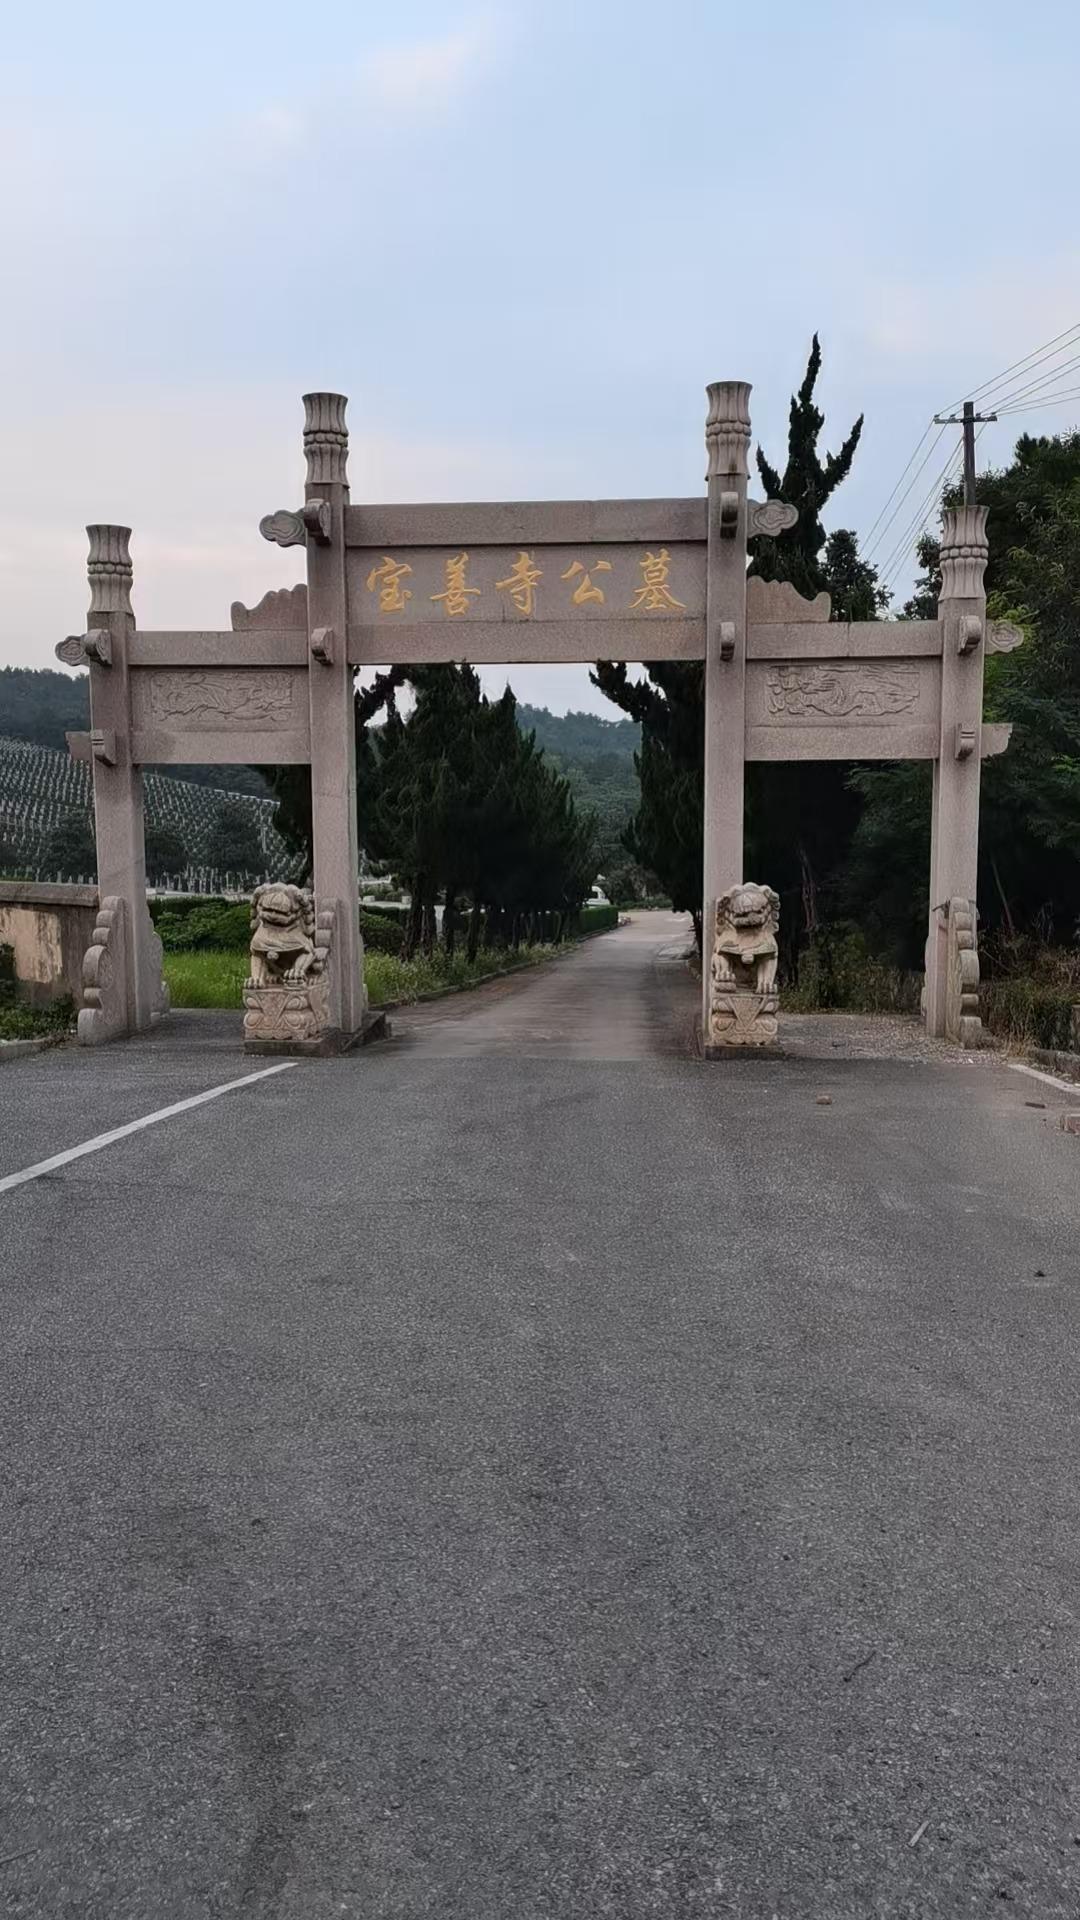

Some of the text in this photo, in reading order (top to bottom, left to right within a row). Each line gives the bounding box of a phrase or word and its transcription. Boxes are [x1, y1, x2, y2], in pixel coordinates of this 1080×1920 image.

[367, 548, 686, 616] 宝善寺公墓
